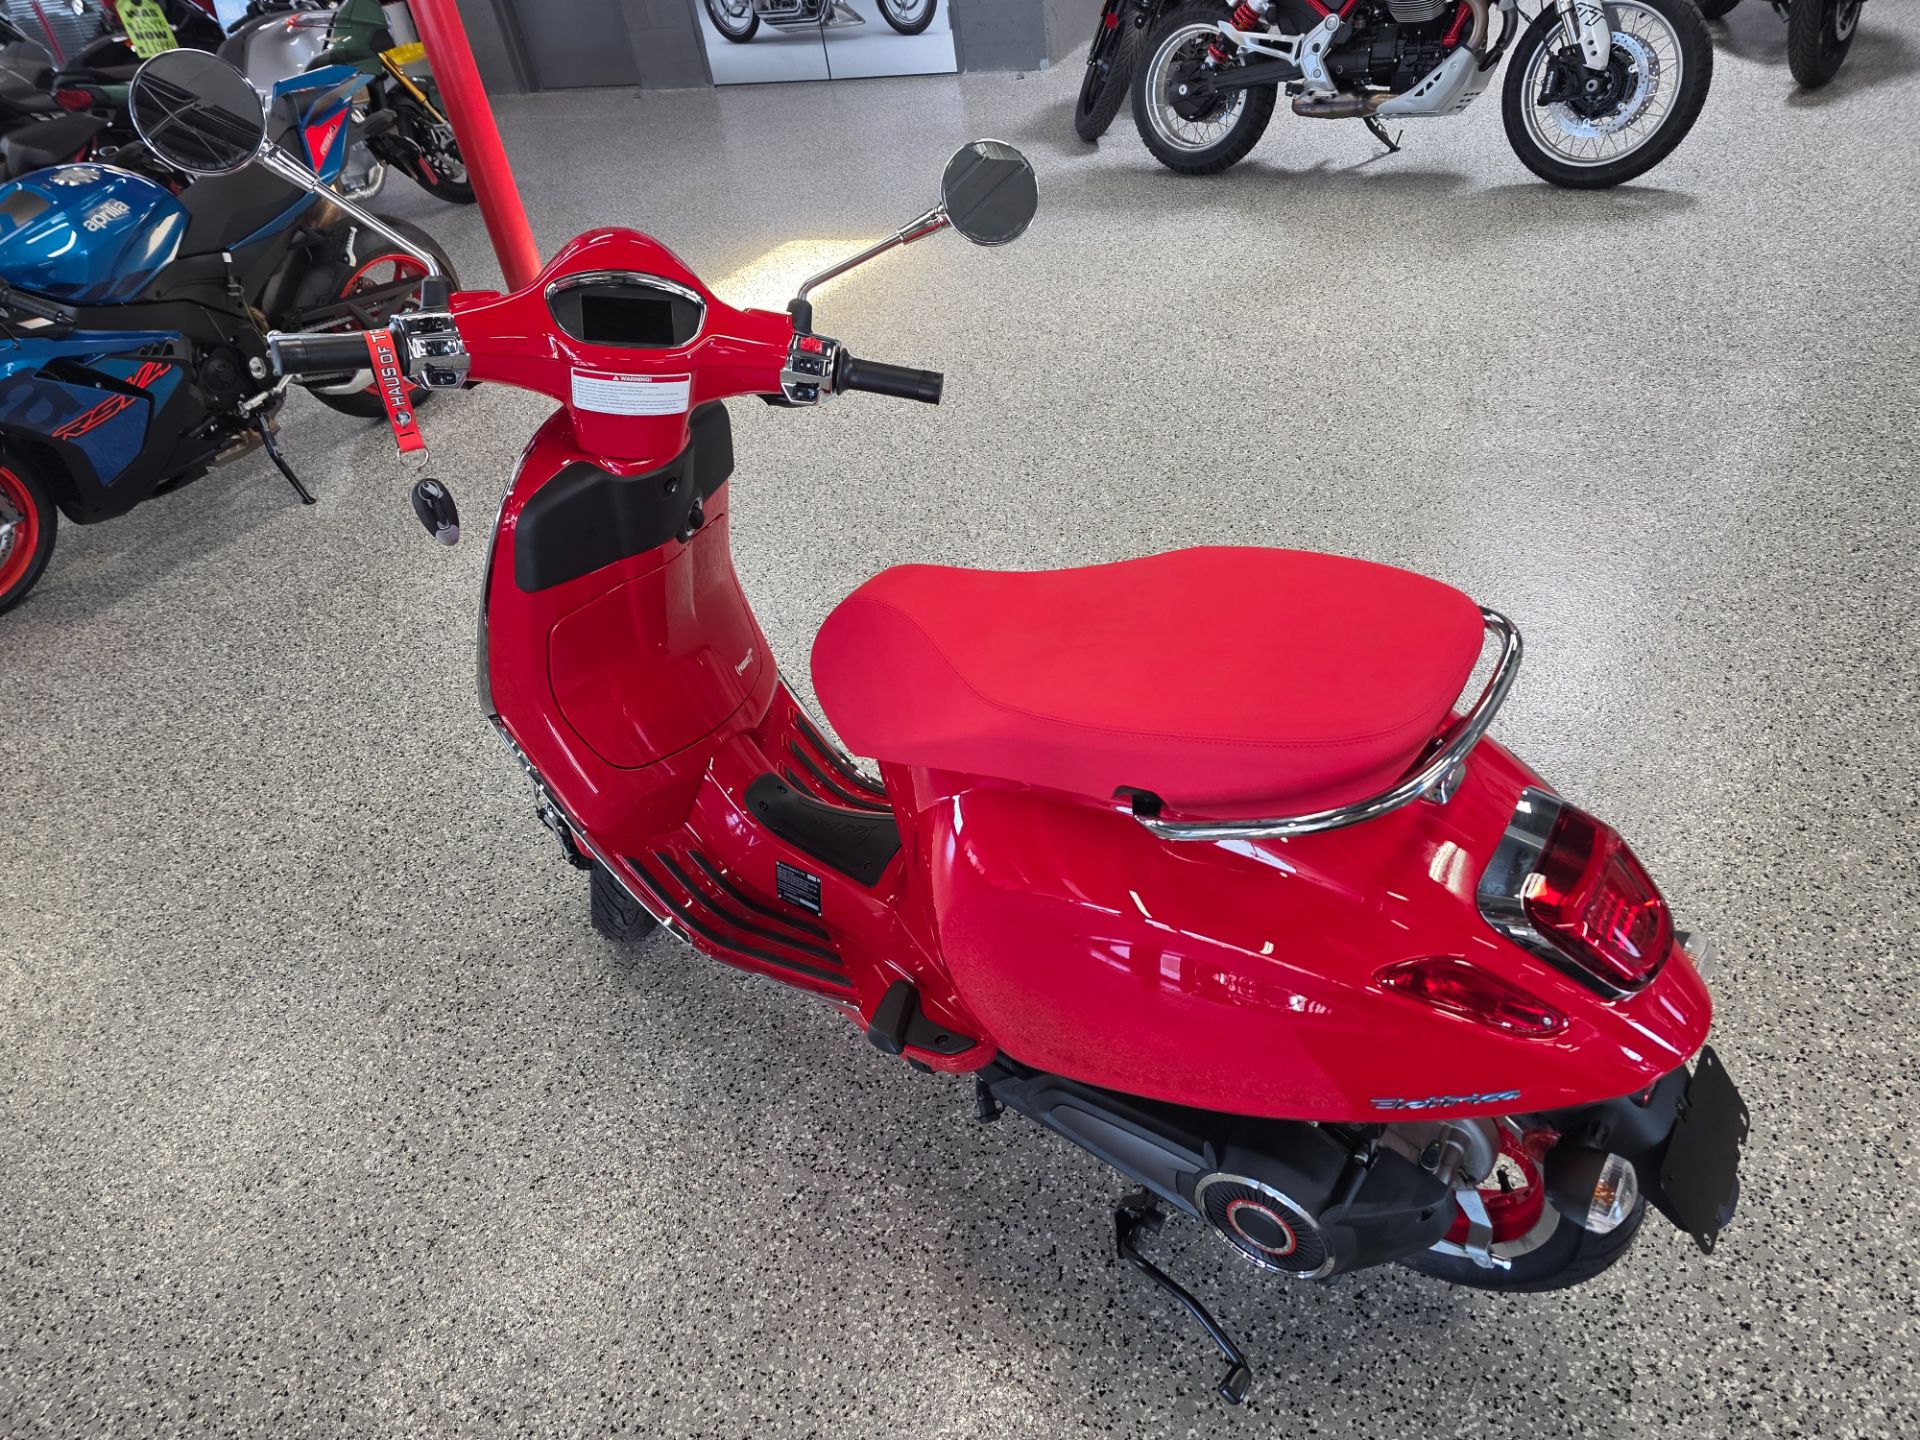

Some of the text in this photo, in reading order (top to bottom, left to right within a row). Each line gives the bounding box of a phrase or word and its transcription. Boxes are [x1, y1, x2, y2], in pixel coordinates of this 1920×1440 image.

[125, 9, 158, 18] WAS
[135, 31, 168, 40] NOW
[83, 200, 130, 231] aprilia
[378, 346, 393, 364] OF
[382, 367, 406, 407] HAUS
[1371, 1090, 1520, 1109] Elettrica
